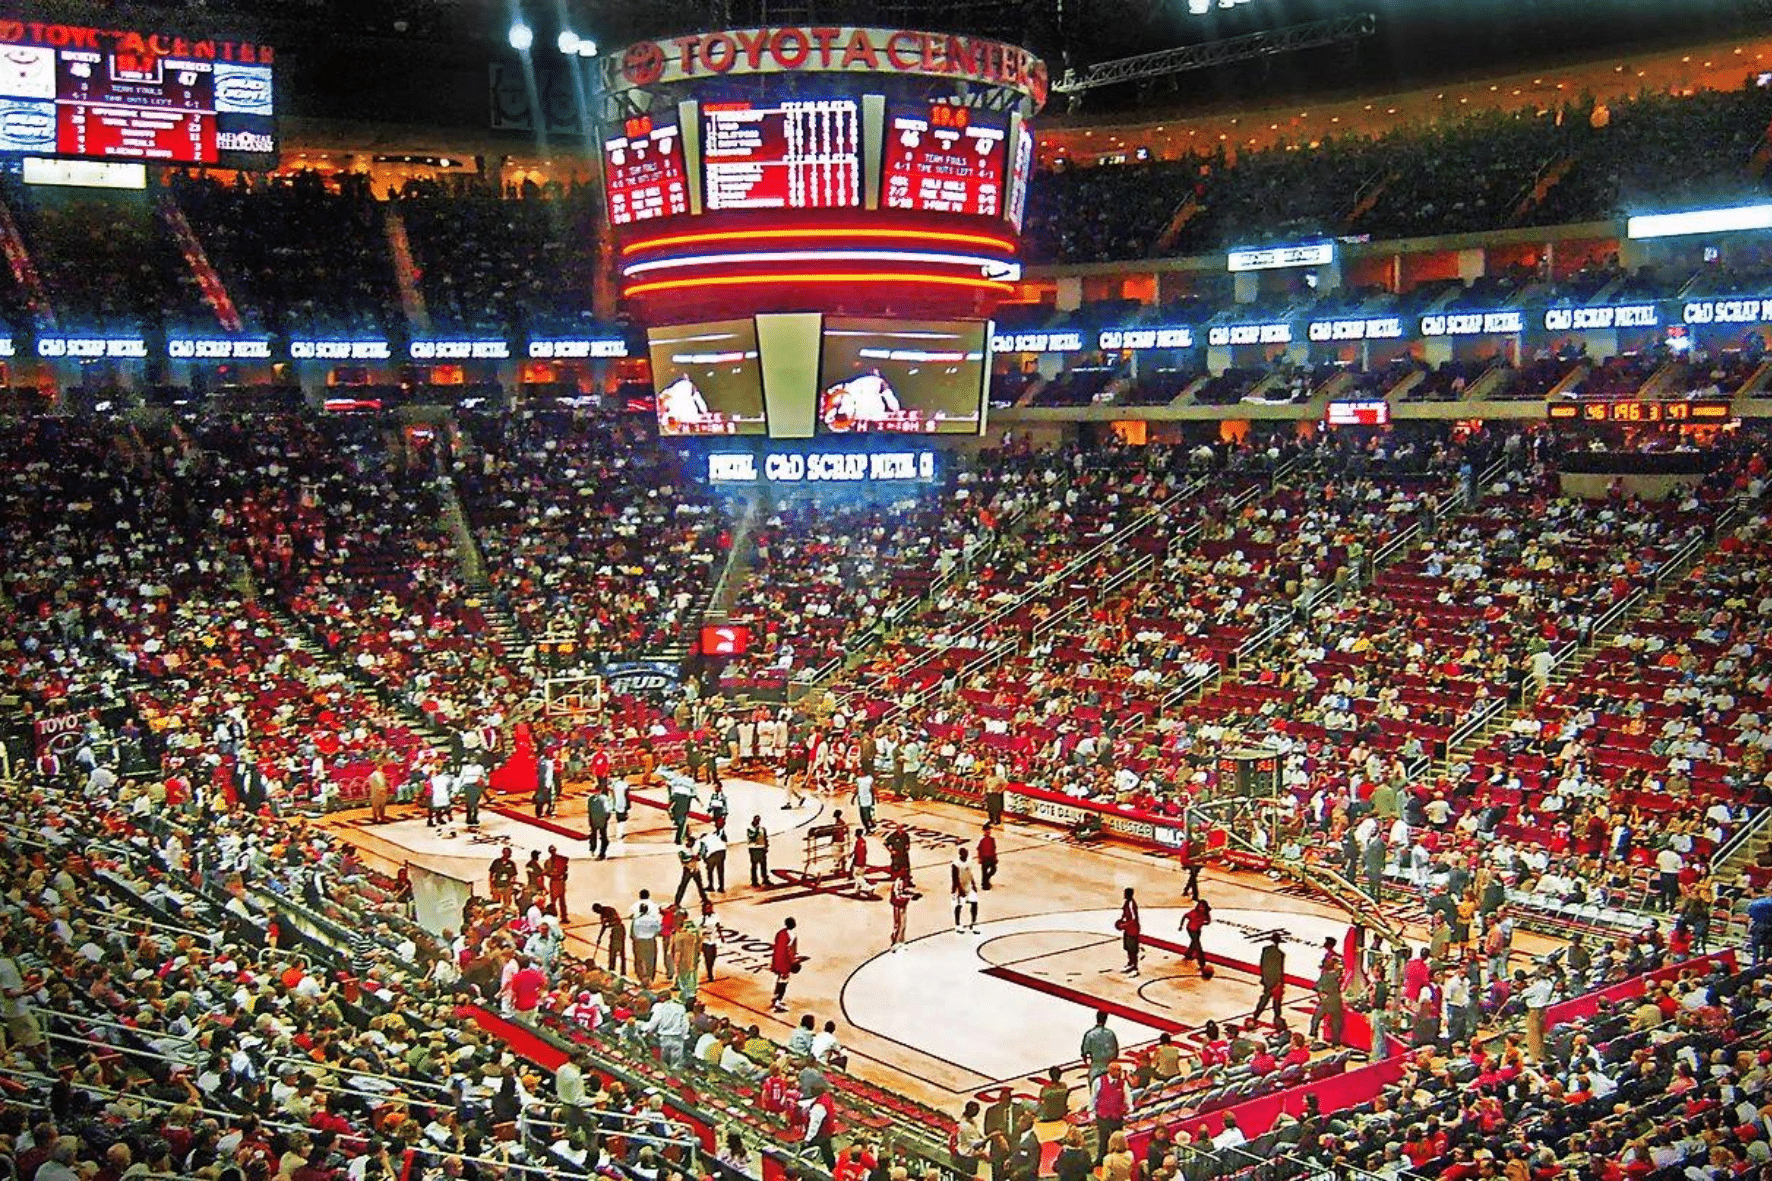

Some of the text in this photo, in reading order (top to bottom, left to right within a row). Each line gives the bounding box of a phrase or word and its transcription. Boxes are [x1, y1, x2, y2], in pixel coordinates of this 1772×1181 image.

[676, 27, 1032, 85] TOYOTA CENTER
[1573, 308, 1613, 328] SCRAP
[1614, 306, 1657, 326] METAL
[1682, 301, 1713, 323] C&D
[1714, 300, 1758, 322] SCRAP
[1332, 319, 1365, 339] SCRAP
[1366, 318, 1402, 337] METAL
[1447, 314, 1483, 333] SCRAP
[1484, 312, 1523, 331] METAL
[1015, 335, 1047, 351] SCRAP
[1048, 333, 1082, 350] METAL
[1123, 331, 1156, 348] SCRAP
[1156, 329, 1192, 347] METAL
[1230, 326, 1260, 344] SCRAP
[1260, 324, 1292, 343] METAL
[766, 454, 803, 480] C&D
[807, 453, 868, 480] SCRAP
[870, 453, 917, 479] METAL
[615, 676, 665, 693] BUD
[1034, 802, 1055, 816] VOTE
